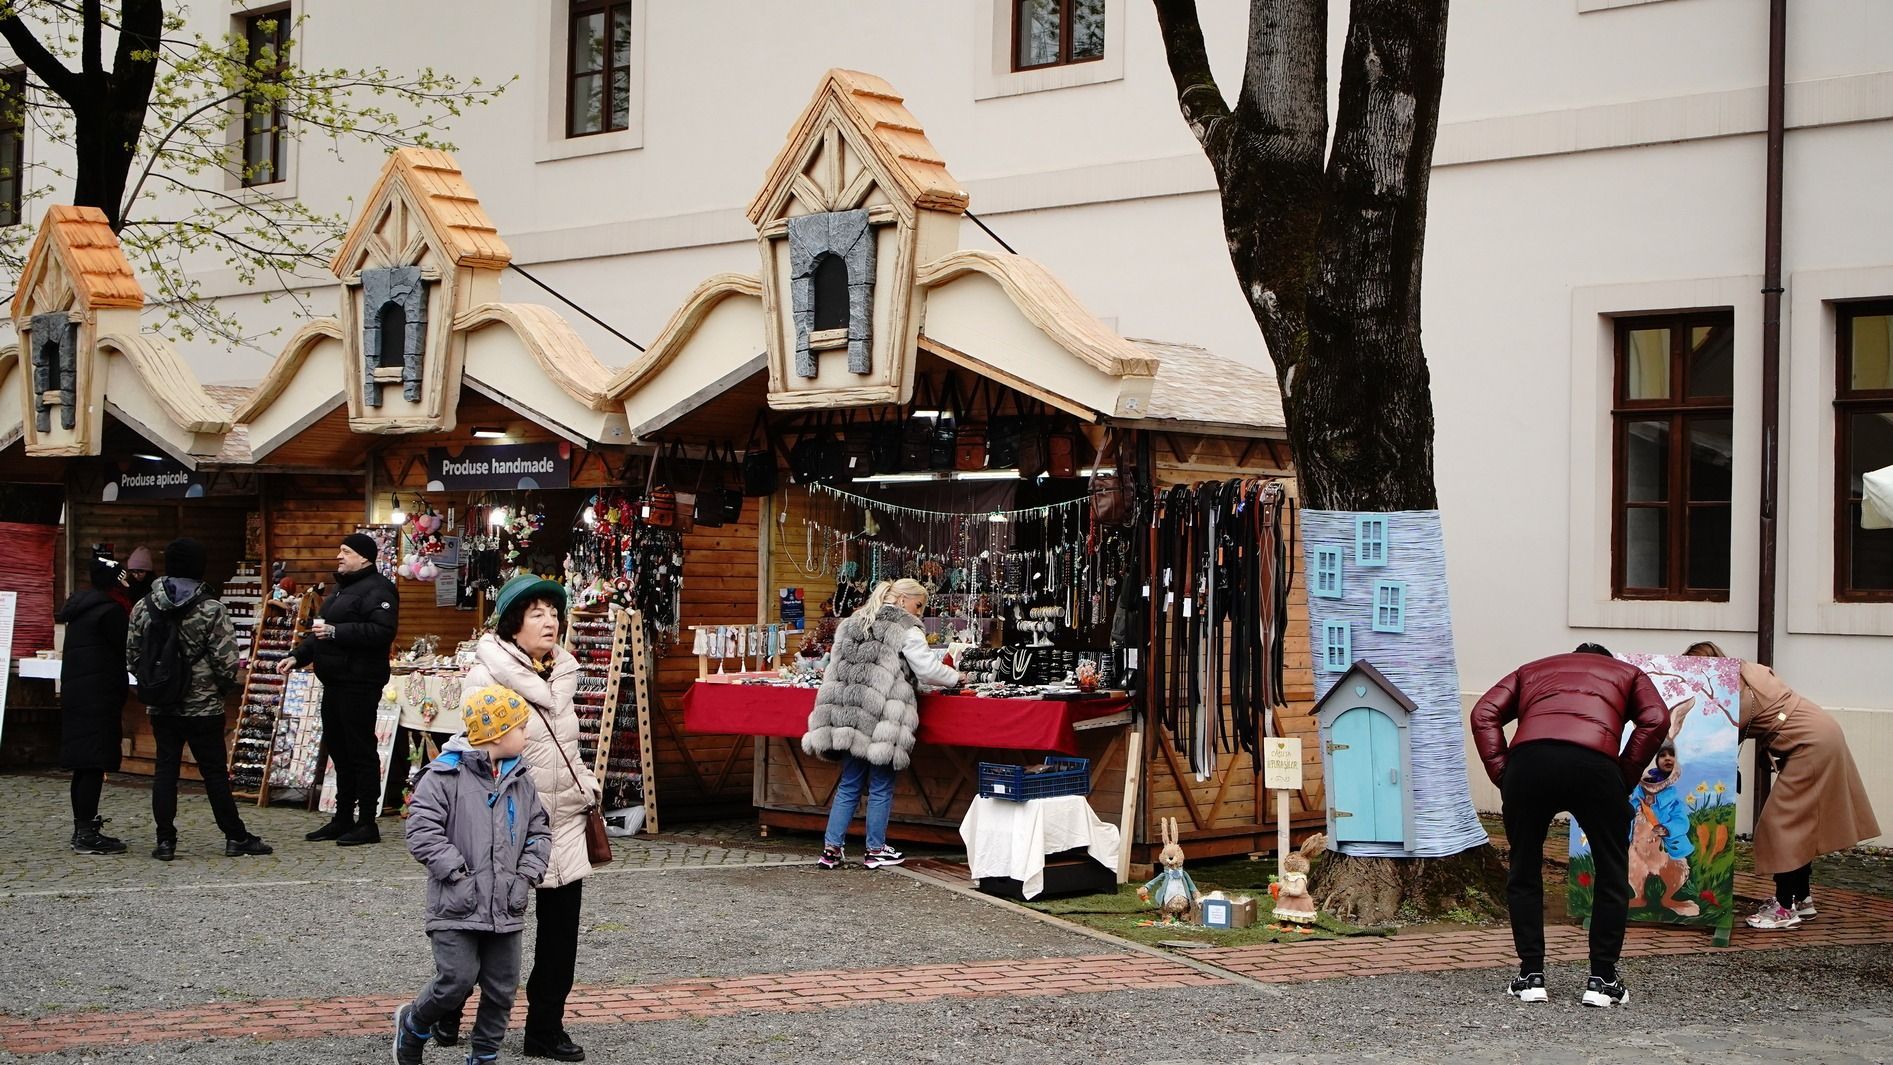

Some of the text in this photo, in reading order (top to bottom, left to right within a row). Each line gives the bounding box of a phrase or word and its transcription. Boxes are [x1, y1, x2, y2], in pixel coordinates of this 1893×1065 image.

[442, 457, 554, 475] Produse handmade
[121, 470, 189, 488] Produse apicole
